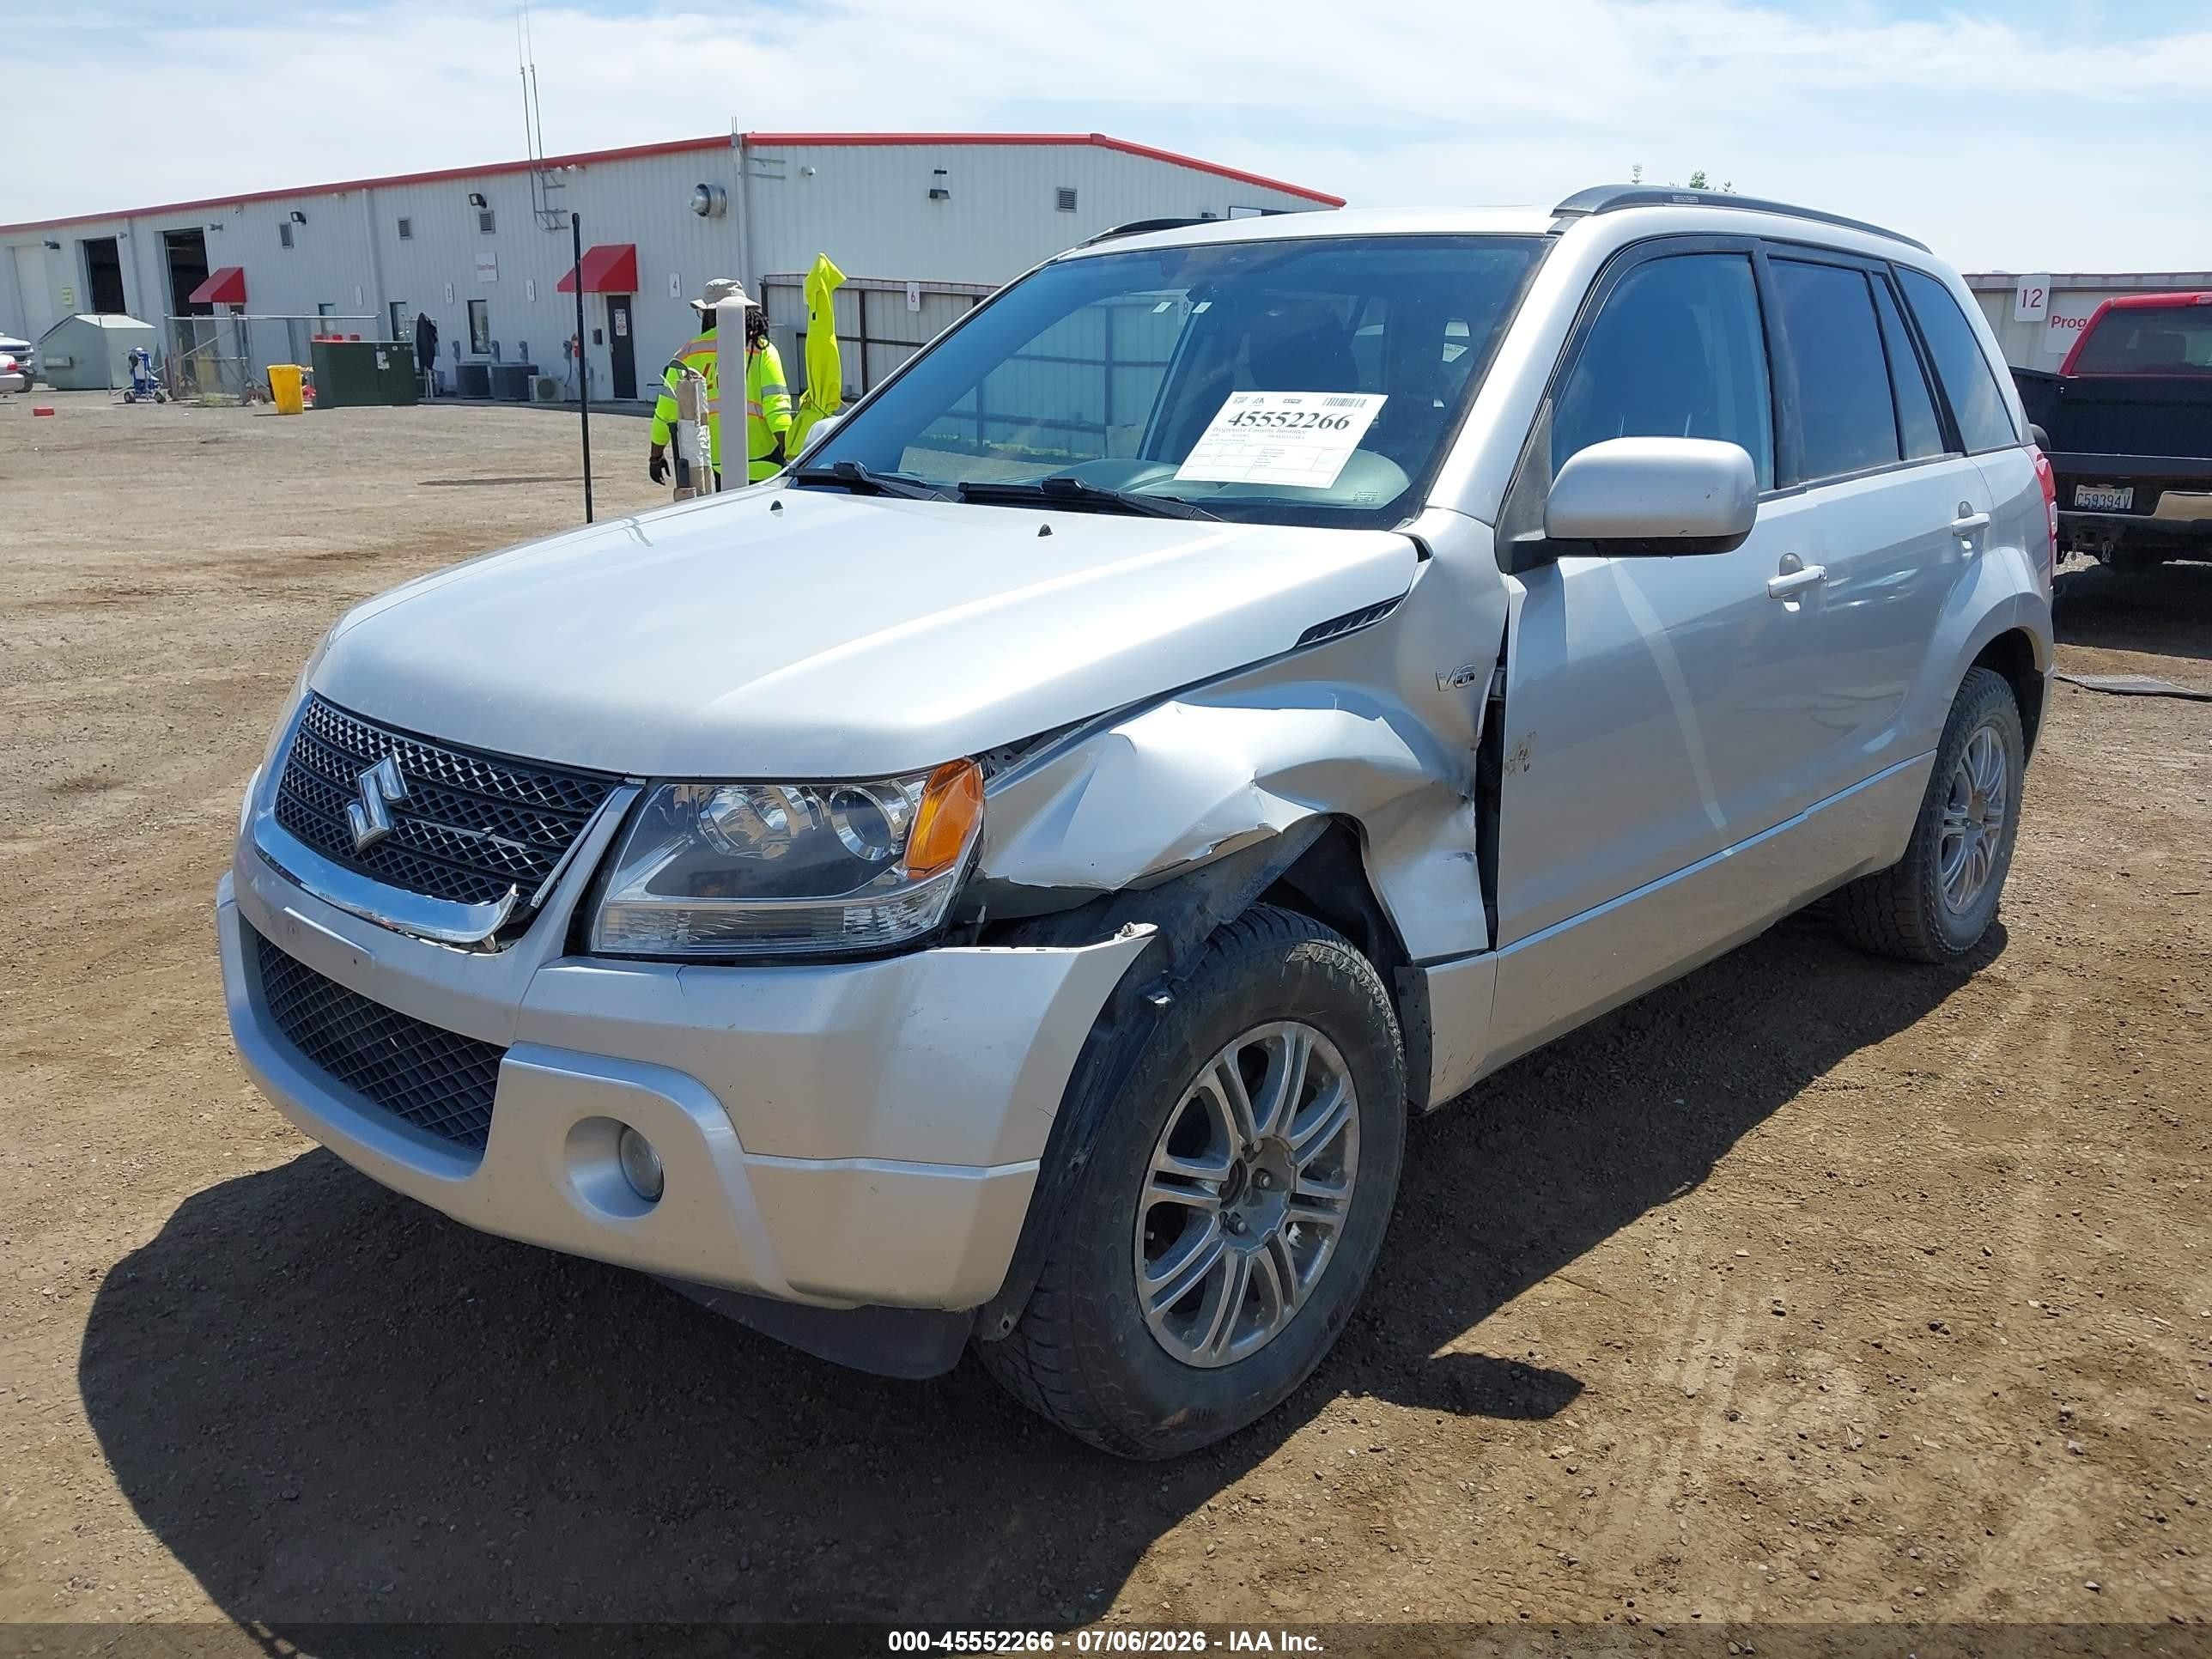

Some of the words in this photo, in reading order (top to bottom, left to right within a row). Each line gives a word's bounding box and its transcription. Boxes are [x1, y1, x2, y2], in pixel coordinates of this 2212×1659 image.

[910, 290, 916, 303] 6
[2022, 288, 2043, 308] 12
[1183, 301, 1188, 316] 8
[2051, 314, 2087, 331] Prog
[1227, 410, 1355, 430] 45552266
